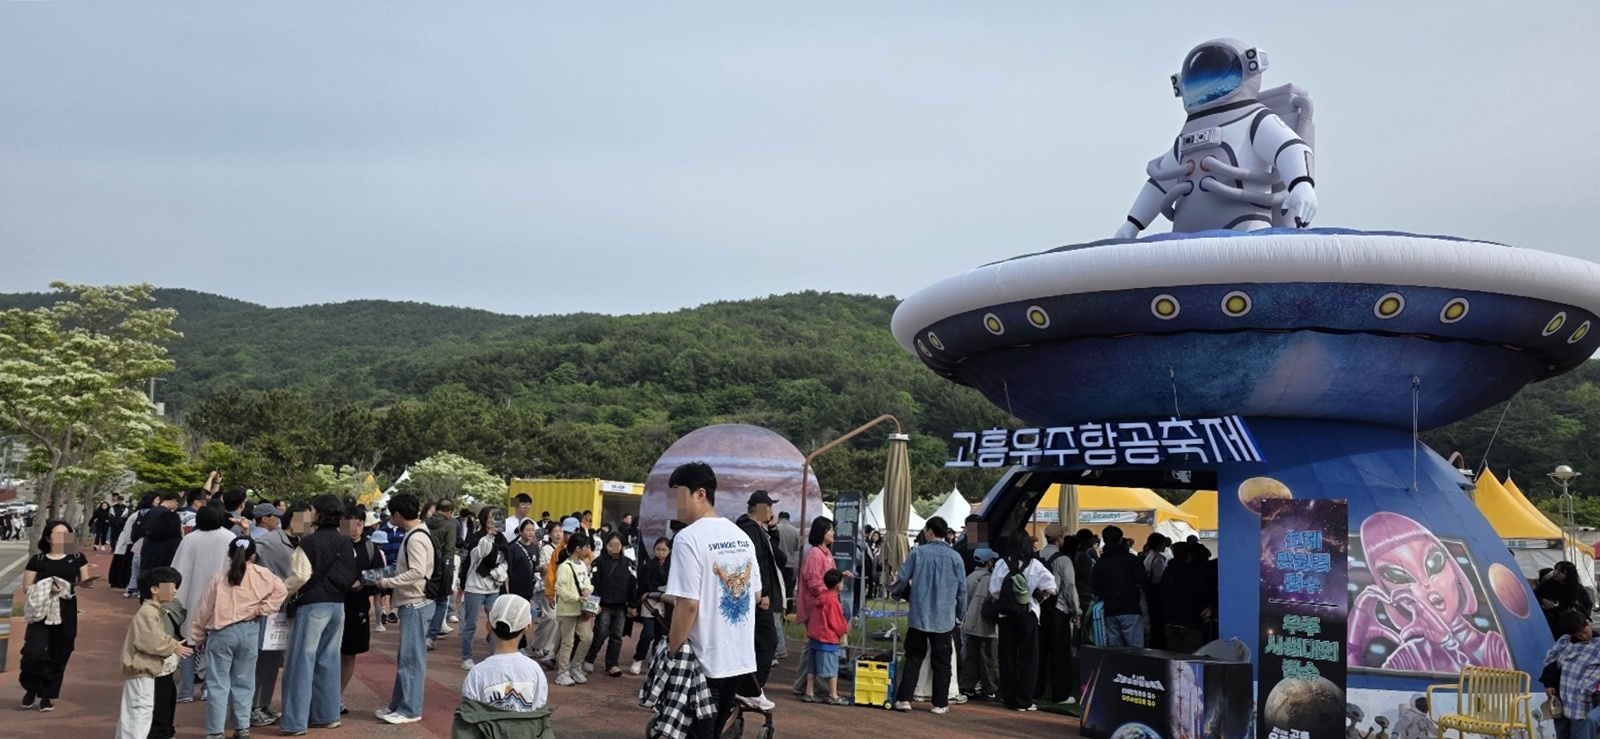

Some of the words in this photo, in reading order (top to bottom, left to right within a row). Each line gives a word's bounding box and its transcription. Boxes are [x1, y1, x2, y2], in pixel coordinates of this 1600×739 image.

[944, 415, 1262, 467] 고흥우주항공축제
[1282, 614, 1322, 636] 우주
[1264, 635, 1339, 662] 사생대회
